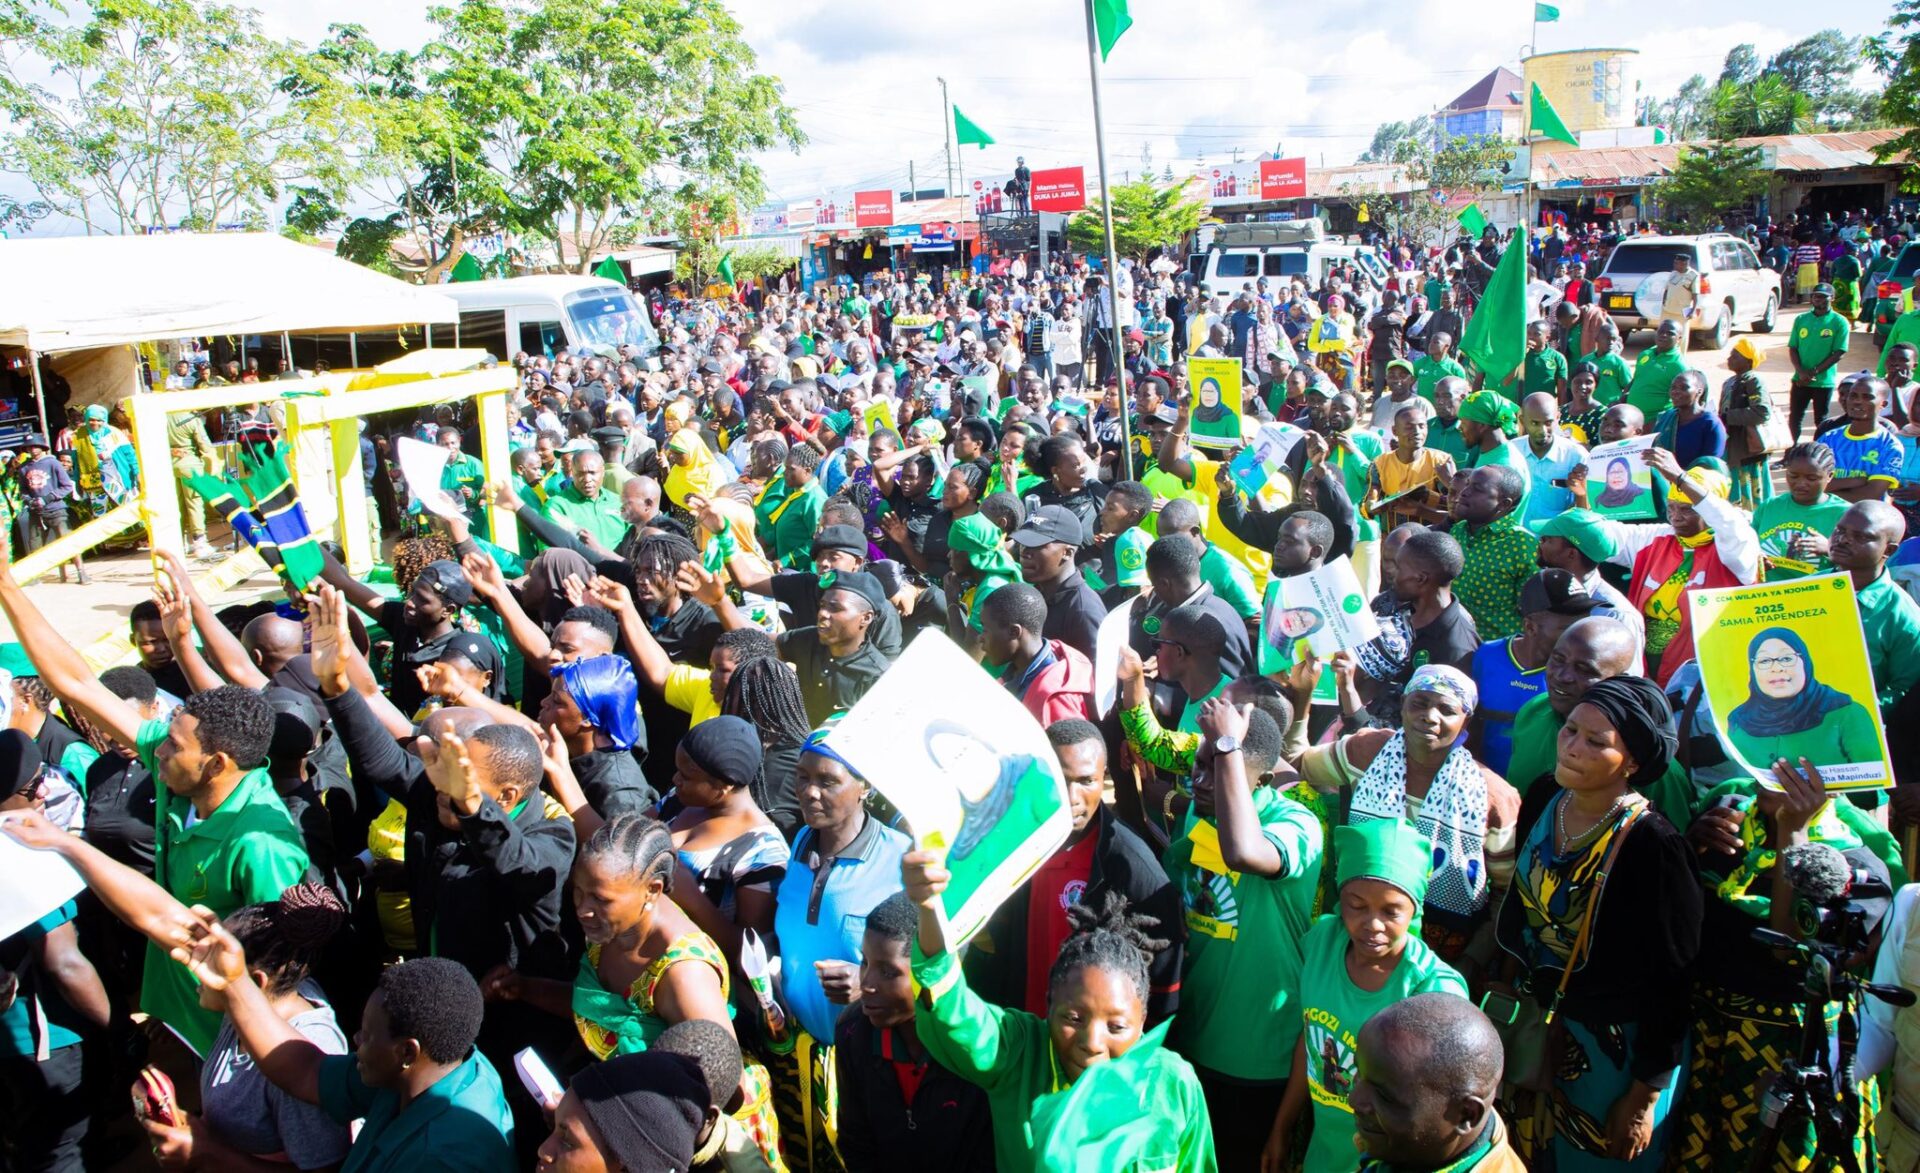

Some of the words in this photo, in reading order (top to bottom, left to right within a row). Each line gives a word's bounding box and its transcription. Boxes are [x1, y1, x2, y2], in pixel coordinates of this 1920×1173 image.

[1734, 591, 1769, 602] WILAYA
[1770, 589, 1782, 597] YA
[1784, 584, 1821, 595] NJOMBE
[1754, 603, 1785, 615] 2025
[1719, 616, 1754, 627] SAMIA
[1756, 607, 1828, 624] ITAPENDEZA
[1829, 765, 1860, 773] Hassan
[1837, 772, 1882, 782] Mapinduzi
